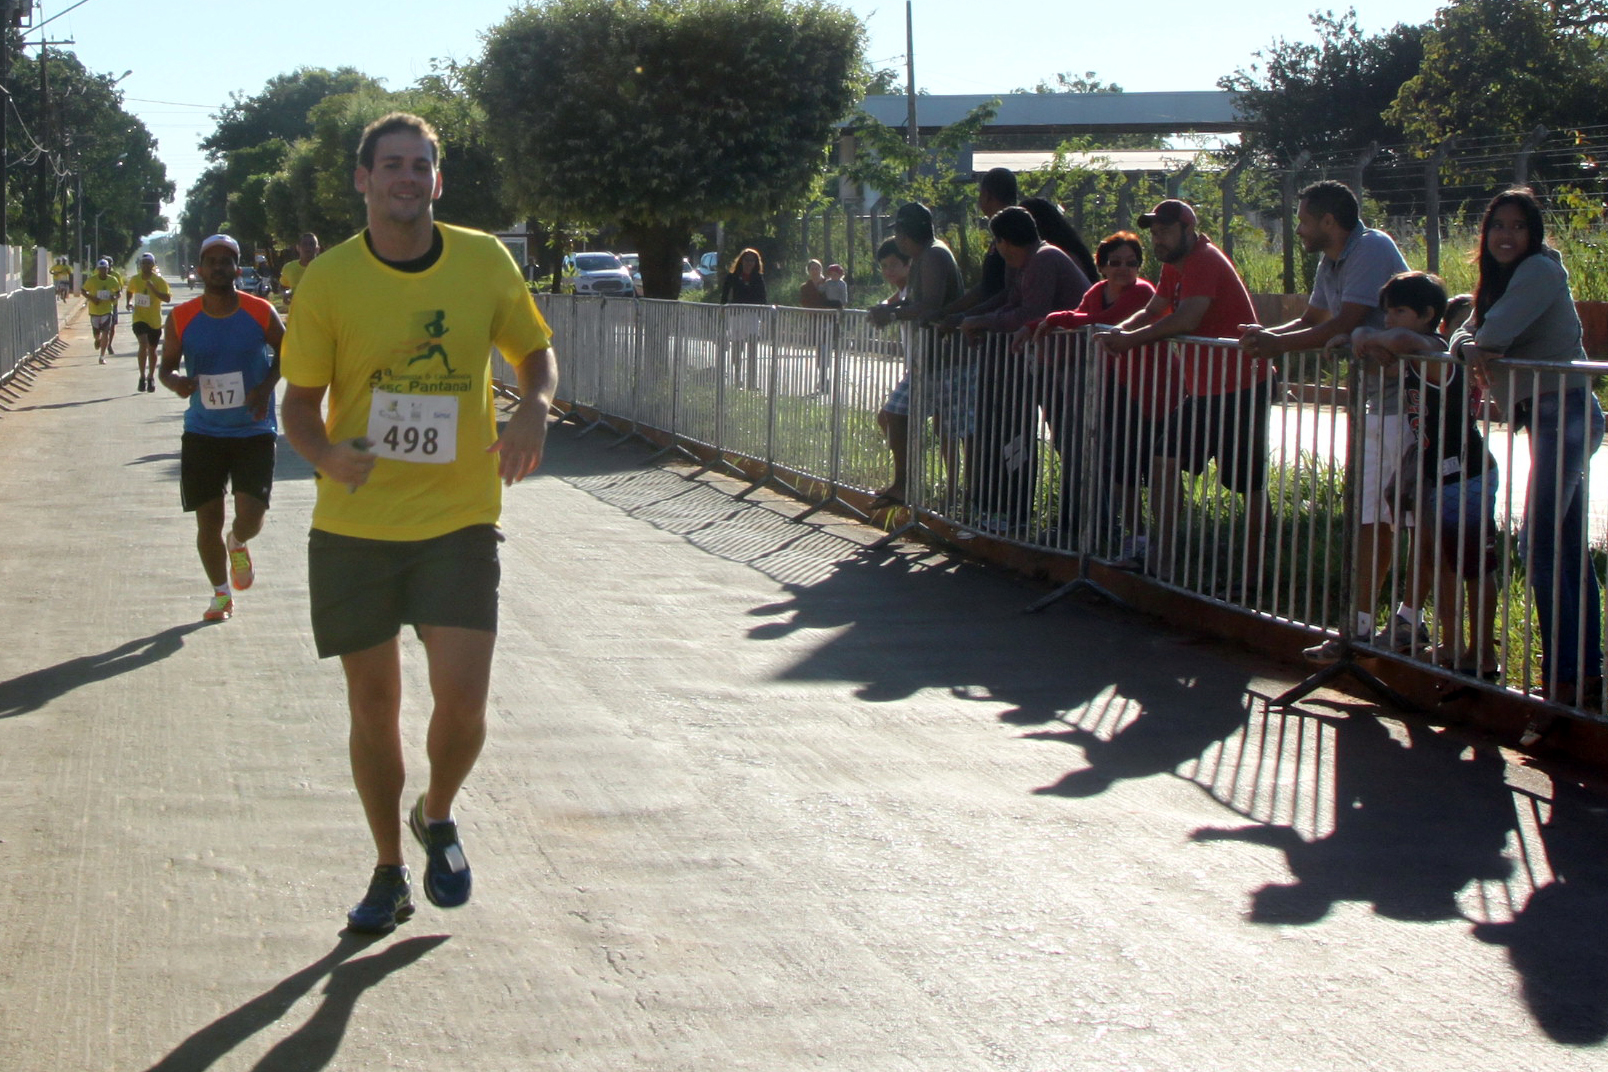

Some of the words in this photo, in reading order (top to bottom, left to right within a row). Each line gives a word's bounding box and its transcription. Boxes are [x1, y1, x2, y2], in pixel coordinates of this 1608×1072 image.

[409, 379, 472, 392] Pantanal
[209, 389, 235, 405] 417
[383, 425, 438, 455] 498
